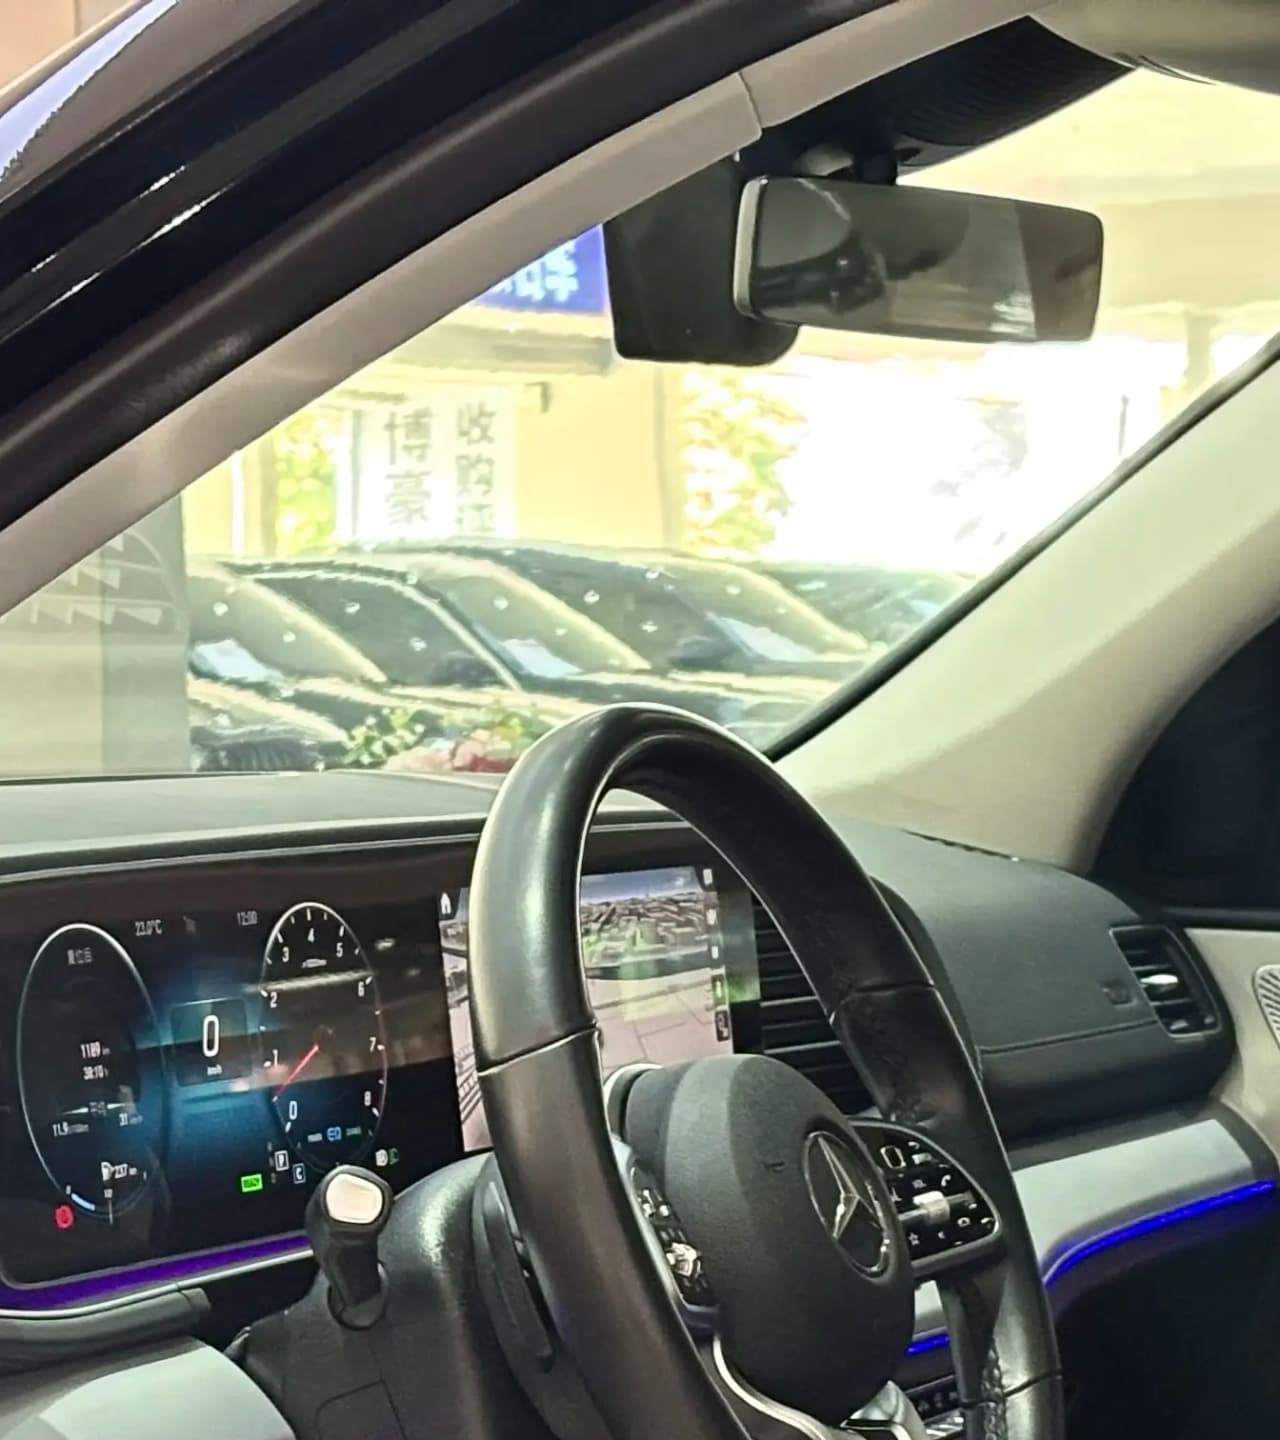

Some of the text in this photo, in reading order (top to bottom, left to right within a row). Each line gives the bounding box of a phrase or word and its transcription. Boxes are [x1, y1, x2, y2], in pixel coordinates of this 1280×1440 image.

[307, 927, 315, 942] 4
[282, 946, 290, 962] 3
[336, 942, 344, 958] 5
[358, 981, 365, 997] 6
[270, 991, 278, 1008] 2
[203, 1014, 220, 1058] 0
[369, 1037, 377, 1051] 7
[272, 1049, 279, 1069] 1
[288, 1100, 298, 1120] 0
